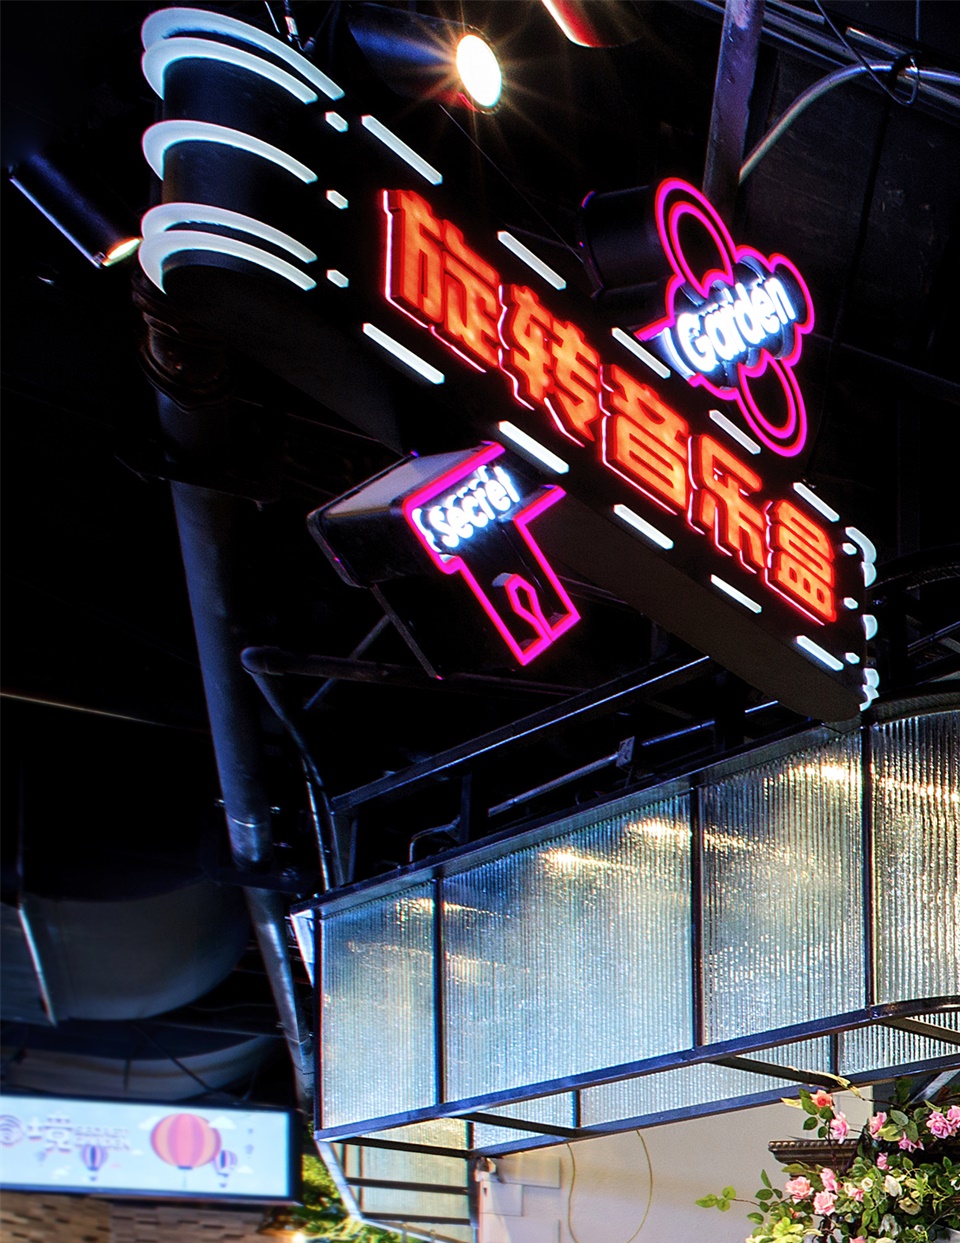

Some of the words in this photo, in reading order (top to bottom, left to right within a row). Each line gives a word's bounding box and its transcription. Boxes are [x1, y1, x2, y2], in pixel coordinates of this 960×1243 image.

[382, 189, 838, 626] 旋转音乐盒
[676, 276, 798, 373] Garden
